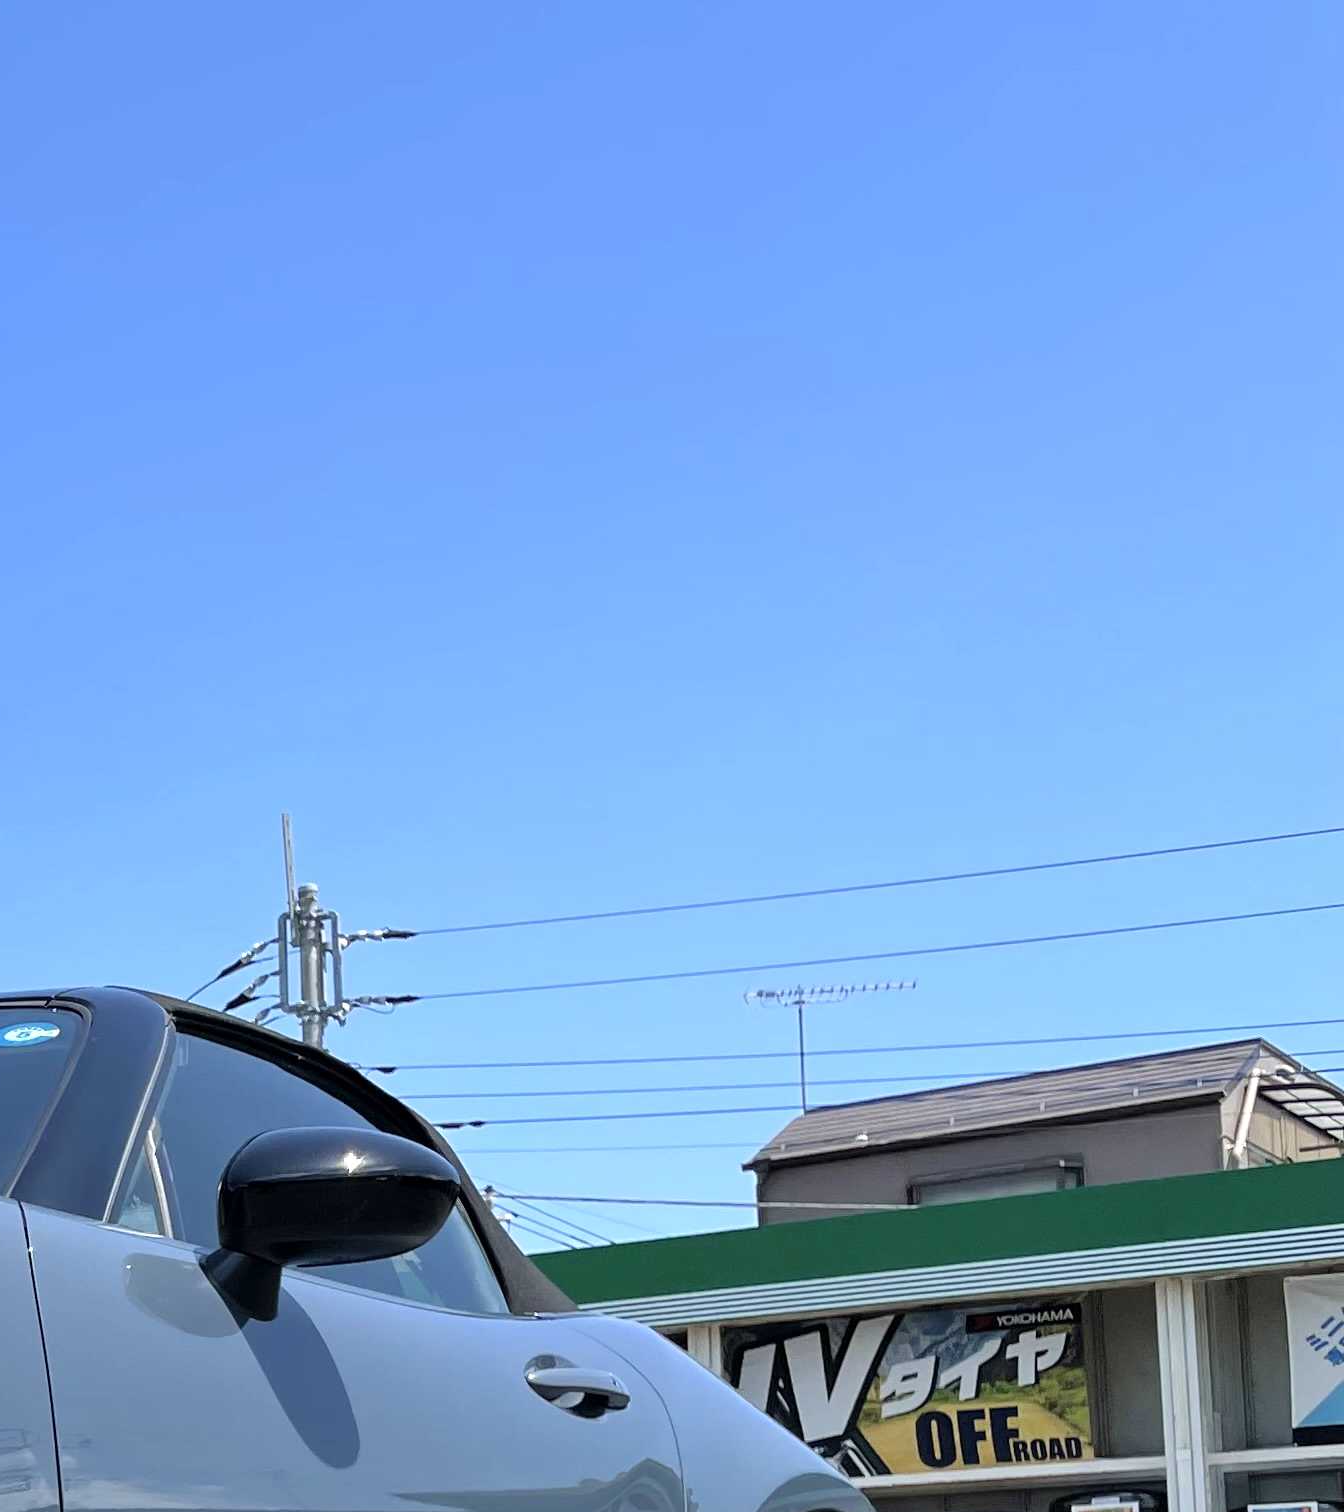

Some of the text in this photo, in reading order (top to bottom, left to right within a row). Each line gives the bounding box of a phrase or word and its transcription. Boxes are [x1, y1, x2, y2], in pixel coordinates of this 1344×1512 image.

[997, 1307, 1074, 1327] YOKOHAMA
[880, 1330, 1067, 1419] タイヤ
[915, 1406, 1082, 1469] OFF ROAD
